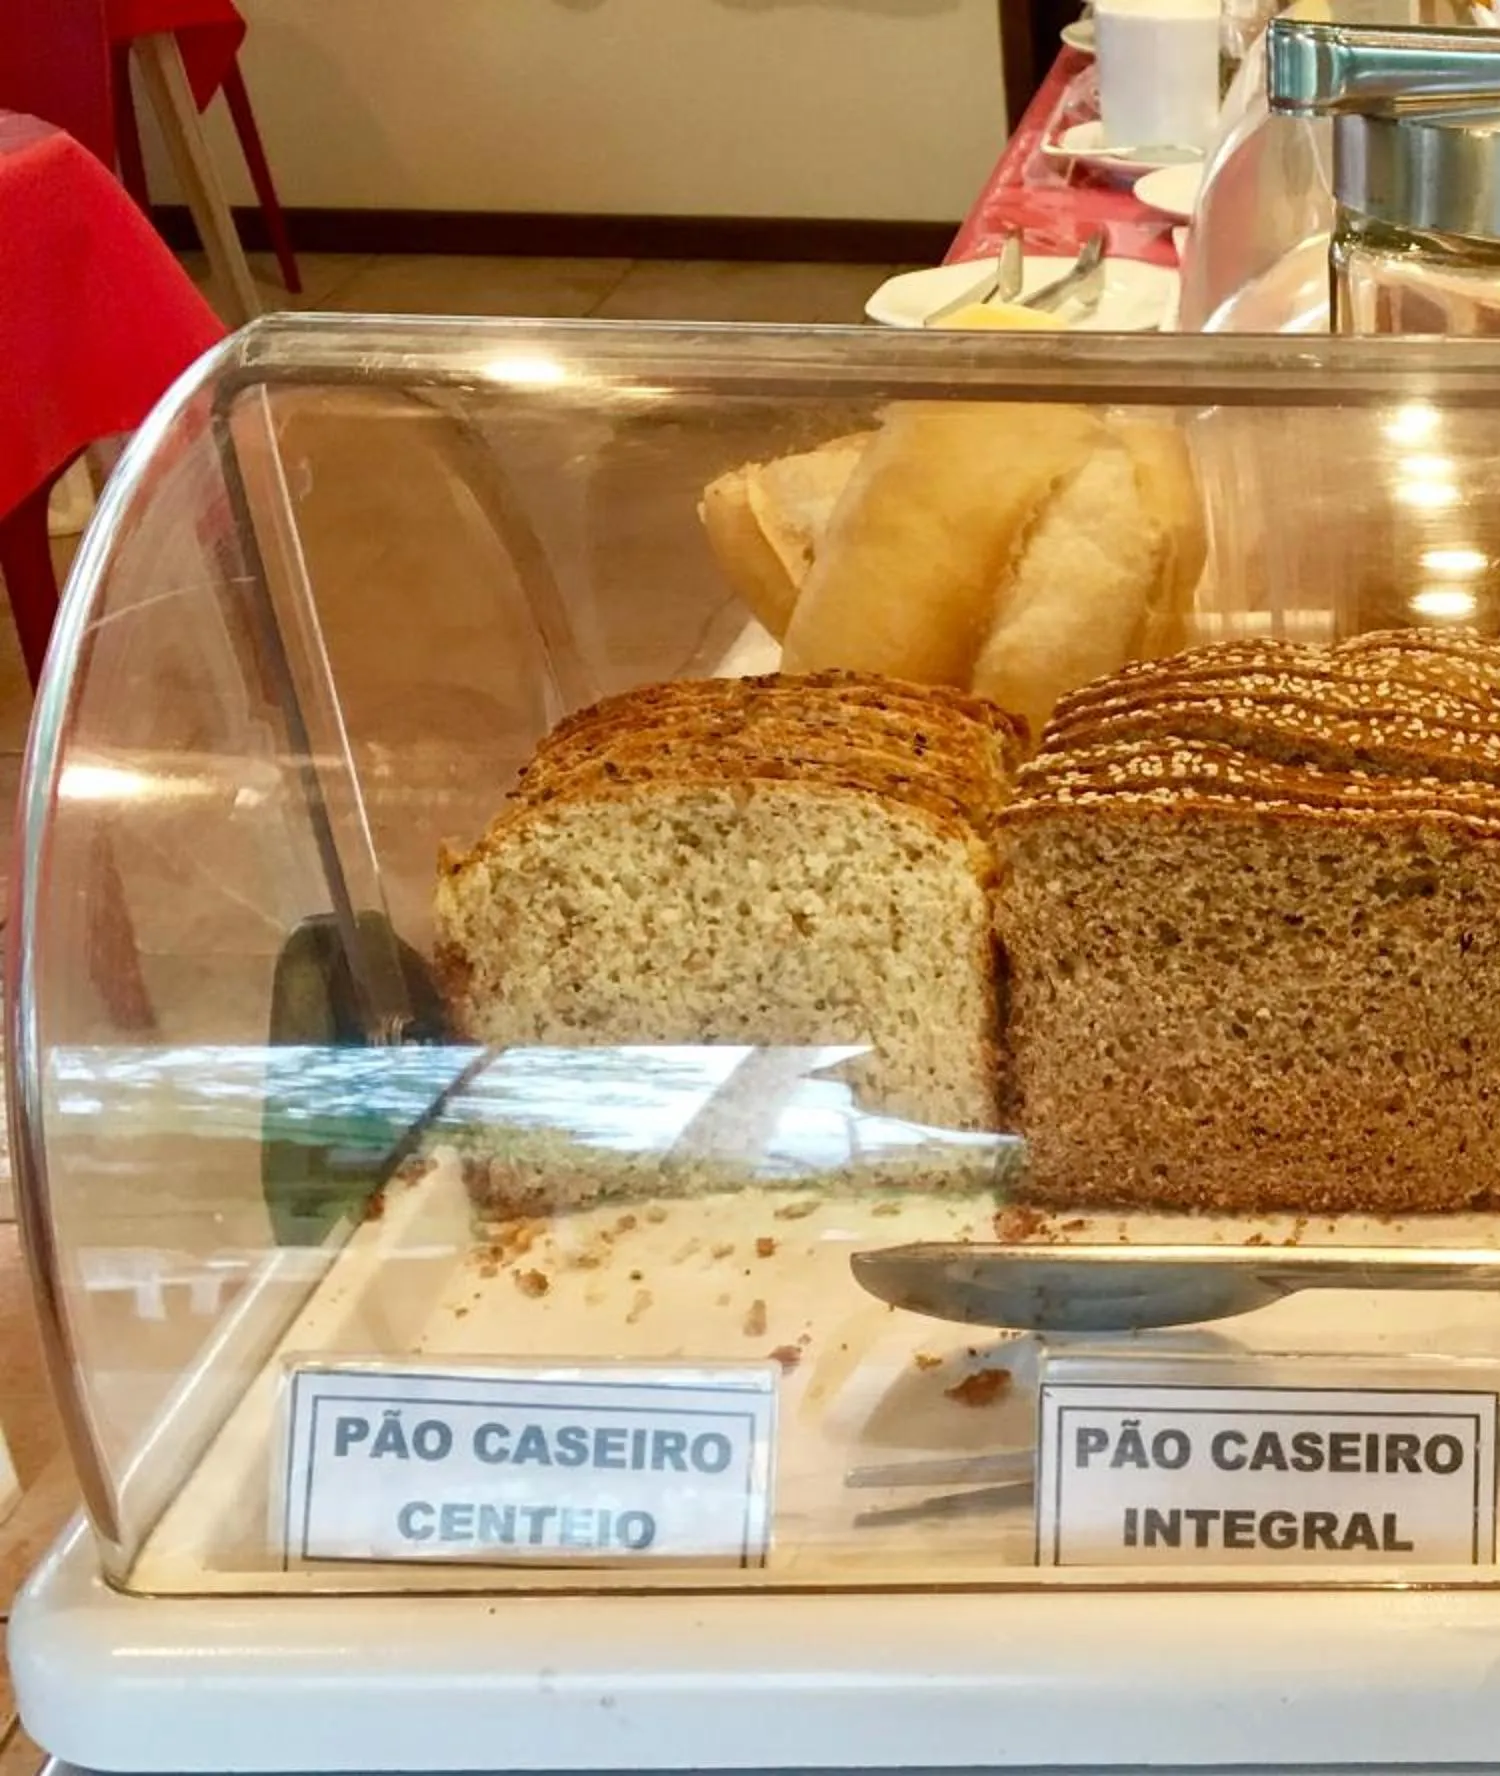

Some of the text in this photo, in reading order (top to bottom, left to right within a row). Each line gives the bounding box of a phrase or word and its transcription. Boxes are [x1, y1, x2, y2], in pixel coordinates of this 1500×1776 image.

[334, 1410, 732, 1473] PÃO CASEIRO
[1075, 1420, 1464, 1474] PÃO CASEIRO
[397, 1501, 656, 1550] CENTEIO
[1123, 1508, 1414, 1552] INTEGRAL
